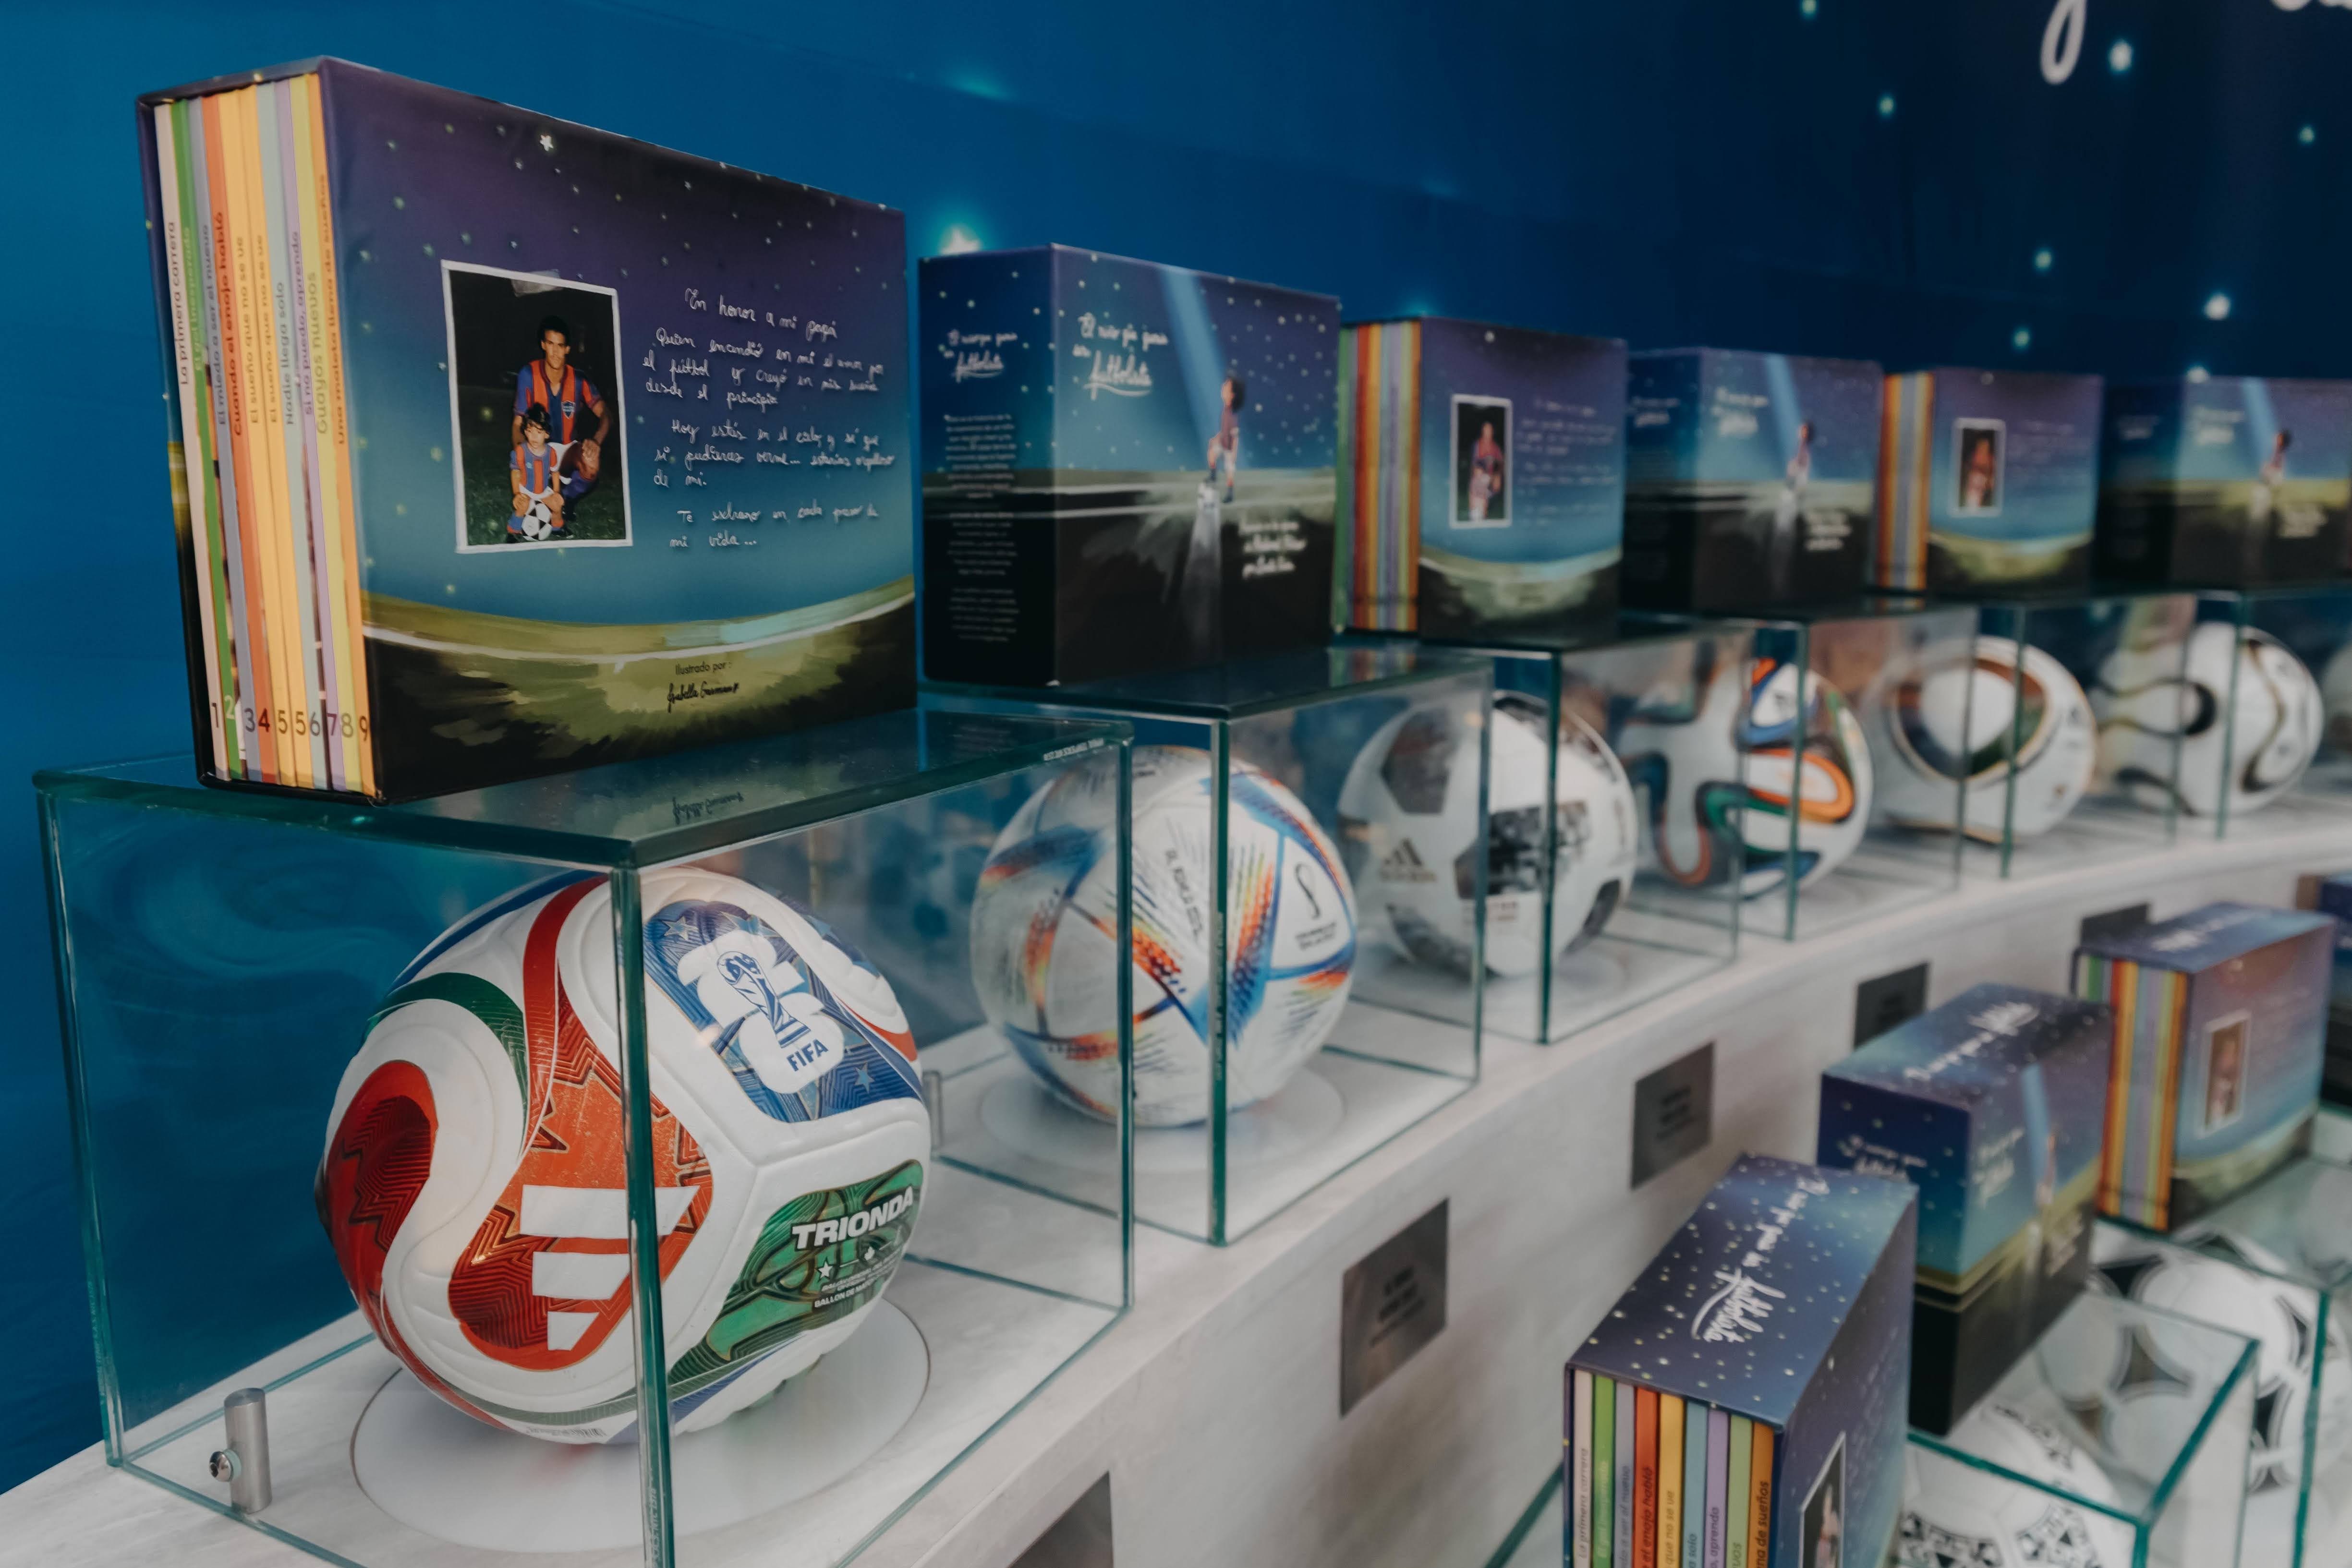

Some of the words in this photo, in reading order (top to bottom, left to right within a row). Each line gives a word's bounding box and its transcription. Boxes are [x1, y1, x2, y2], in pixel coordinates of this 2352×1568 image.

[202, 225, 213, 280] nuevo
[215, 212, 227, 269] habló
[169, 222, 181, 287] carrera
[238, 263, 246, 281] se
[258, 262, 266, 280] se
[291, 231, 304, 306] aprendo
[205, 285, 215, 300] el
[221, 275, 232, 331] enojo
[242, 286, 249, 308] no
[261, 286, 268, 307] no
[276, 281, 286, 318] solo
[208, 306, 217, 330] ser
[307, 272, 321, 348] nuevos
[719, 294, 756, 321] honor
[766, 312, 775, 327] a
[173, 291, 188, 360] primera
[243, 312, 253, 346] que
[263, 312, 273, 346] que
[211, 336, 218, 346] a
[226, 336, 235, 350] el
[279, 324, 289, 368] llega
[181, 366, 189, 385] La
[211, 350, 224, 405] miedo
[245, 352, 257, 404] sueño
[265, 350, 276, 403] sueño
[331, 332, 342, 399] maleta
[642, 350, 656, 371] el
[731, 367, 746, 386] y
[303, 375, 311, 395] no
[314, 355, 328, 434] Guayos
[646, 378, 683, 398] desde
[228, 360, 242, 436] Cuando
[282, 373, 294, 425] Nadie
[218, 410, 226, 425] El
[251, 410, 258, 423] El
[270, 409, 277, 423] El
[337, 407, 345, 445] Una
[671, 419, 700, 444] Hoy
[654, 469, 670, 488] de
[677, 510, 694, 522] Te
[670, 534, 688, 547] mi
[675, 661, 711, 675] Ilustrado
[212, 702, 219, 728] 1
[224, 695, 236, 719] 2
[243, 708, 256, 733] 3
[257, 708, 270, 733] 4
[277, 710, 288, 734] 5
[295, 711, 306, 736] 5
[310, 711, 320, 736] 6
[326, 712, 338, 736] 7
[339, 712, 354, 738] 8
[359, 716, 369, 742] 9
[786, 1038, 829, 1072] FIFA
[792, 1186, 913, 1250] TRIONDA
[1756, 1480, 1769, 1527] sueños
[1666, 1524, 1673, 1536] no
[1709, 1507, 1720, 1557] aprendo
[1755, 1530, 1767, 1547] de
[1687, 1533, 1697, 1557] solo
